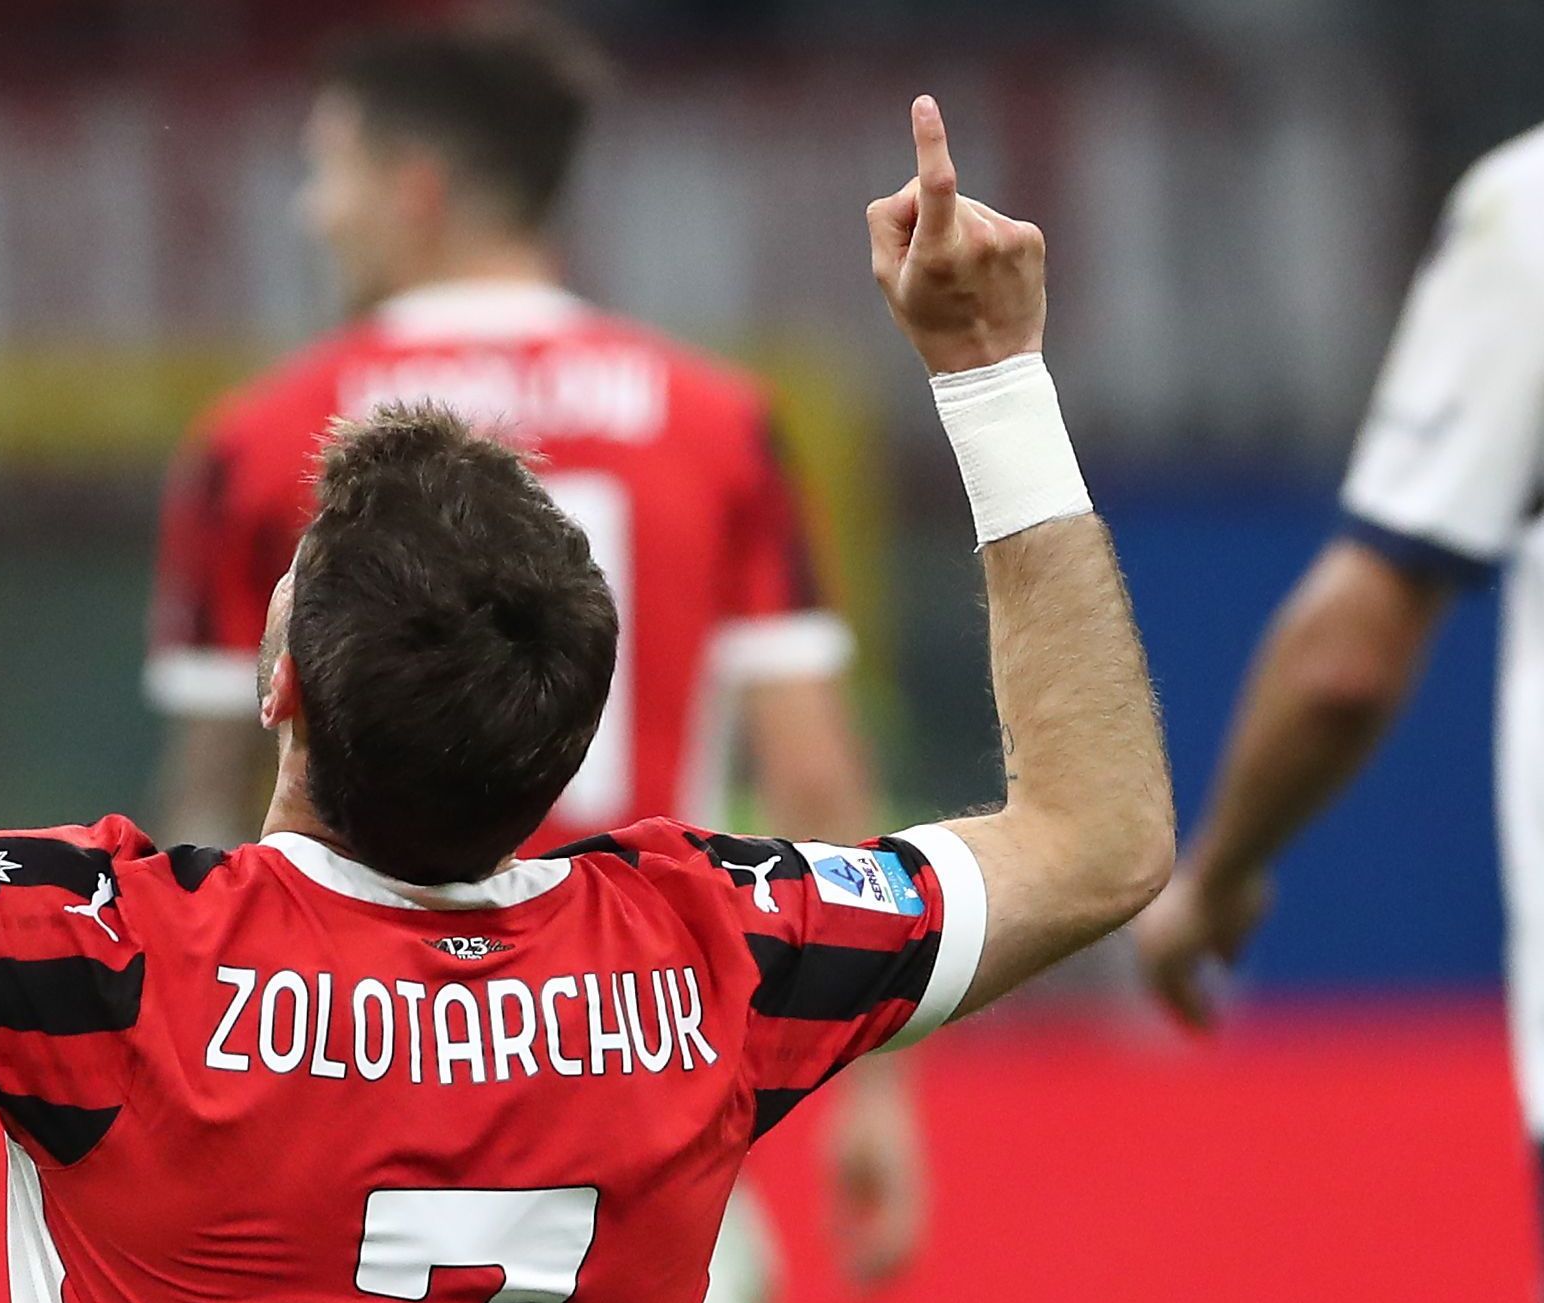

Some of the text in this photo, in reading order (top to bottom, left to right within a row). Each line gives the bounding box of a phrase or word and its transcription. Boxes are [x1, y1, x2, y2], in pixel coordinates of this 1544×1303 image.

[862, 866, 885, 902] SERIE
[442, 937, 488, 955] 125
[205, 966, 719, 1084] ZOLOTARCHUK
